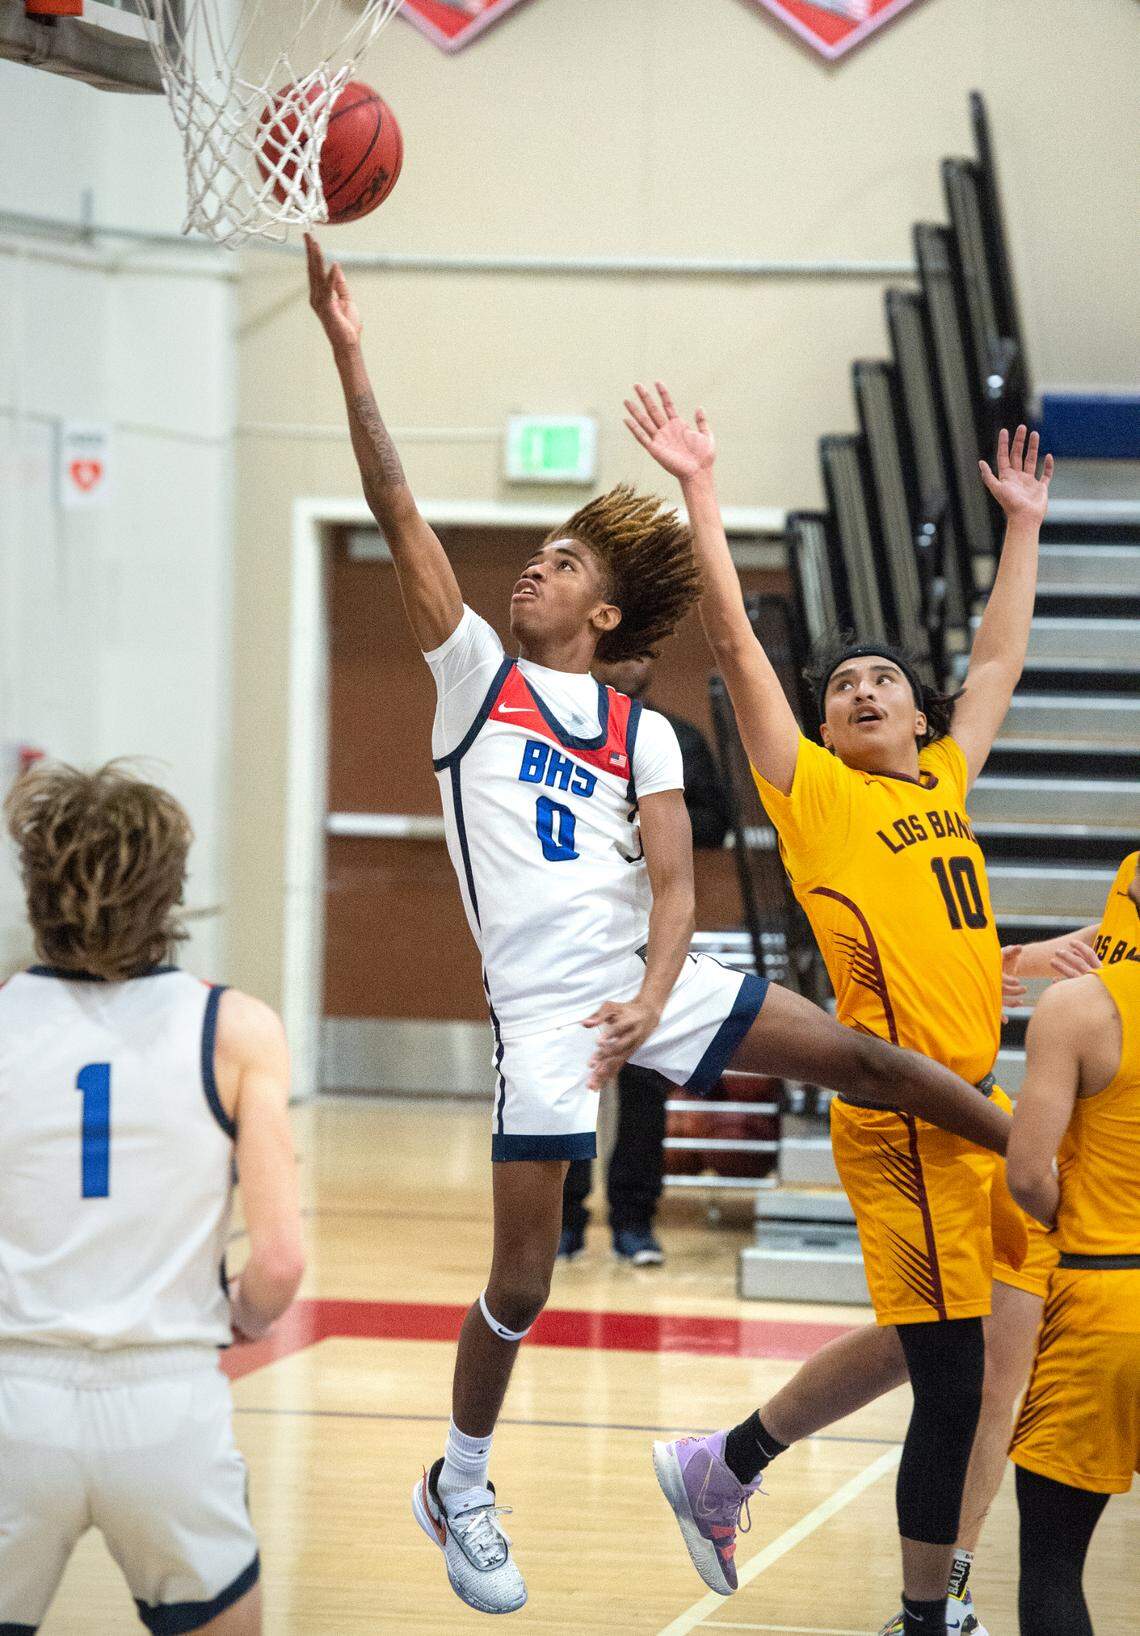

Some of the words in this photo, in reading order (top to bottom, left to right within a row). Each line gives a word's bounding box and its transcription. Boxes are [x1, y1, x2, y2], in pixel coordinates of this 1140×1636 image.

[518, 739, 598, 798] BHS
[535, 795, 580, 862] 0
[876, 814, 929, 854] LOS
[926, 810, 978, 845] BAN
[930, 856, 988, 930] 10
[75, 1062, 111, 1199] 1
